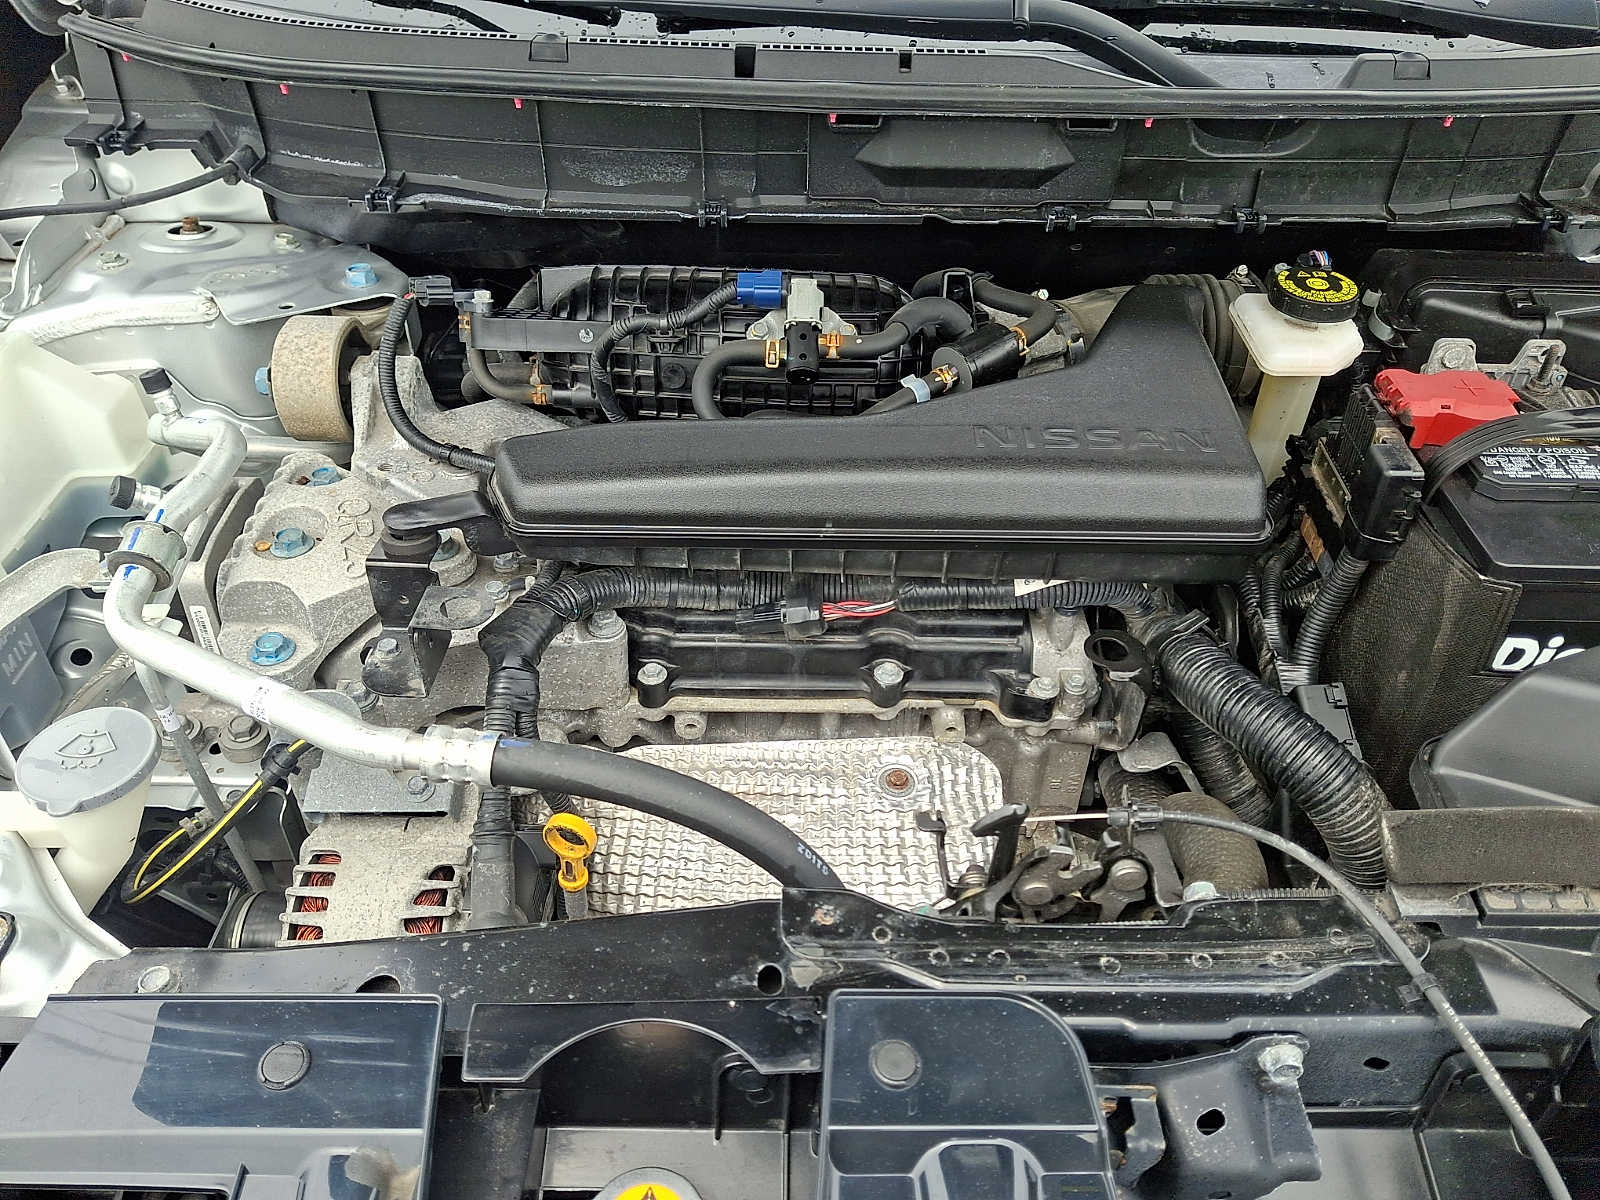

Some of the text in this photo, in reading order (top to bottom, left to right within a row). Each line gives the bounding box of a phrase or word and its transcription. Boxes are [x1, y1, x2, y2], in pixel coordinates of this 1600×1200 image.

[969, 424, 1218, 453] NISSAN
[1, 631, 34, 677] MIN
[1492, 636, 1585, 671] Di
